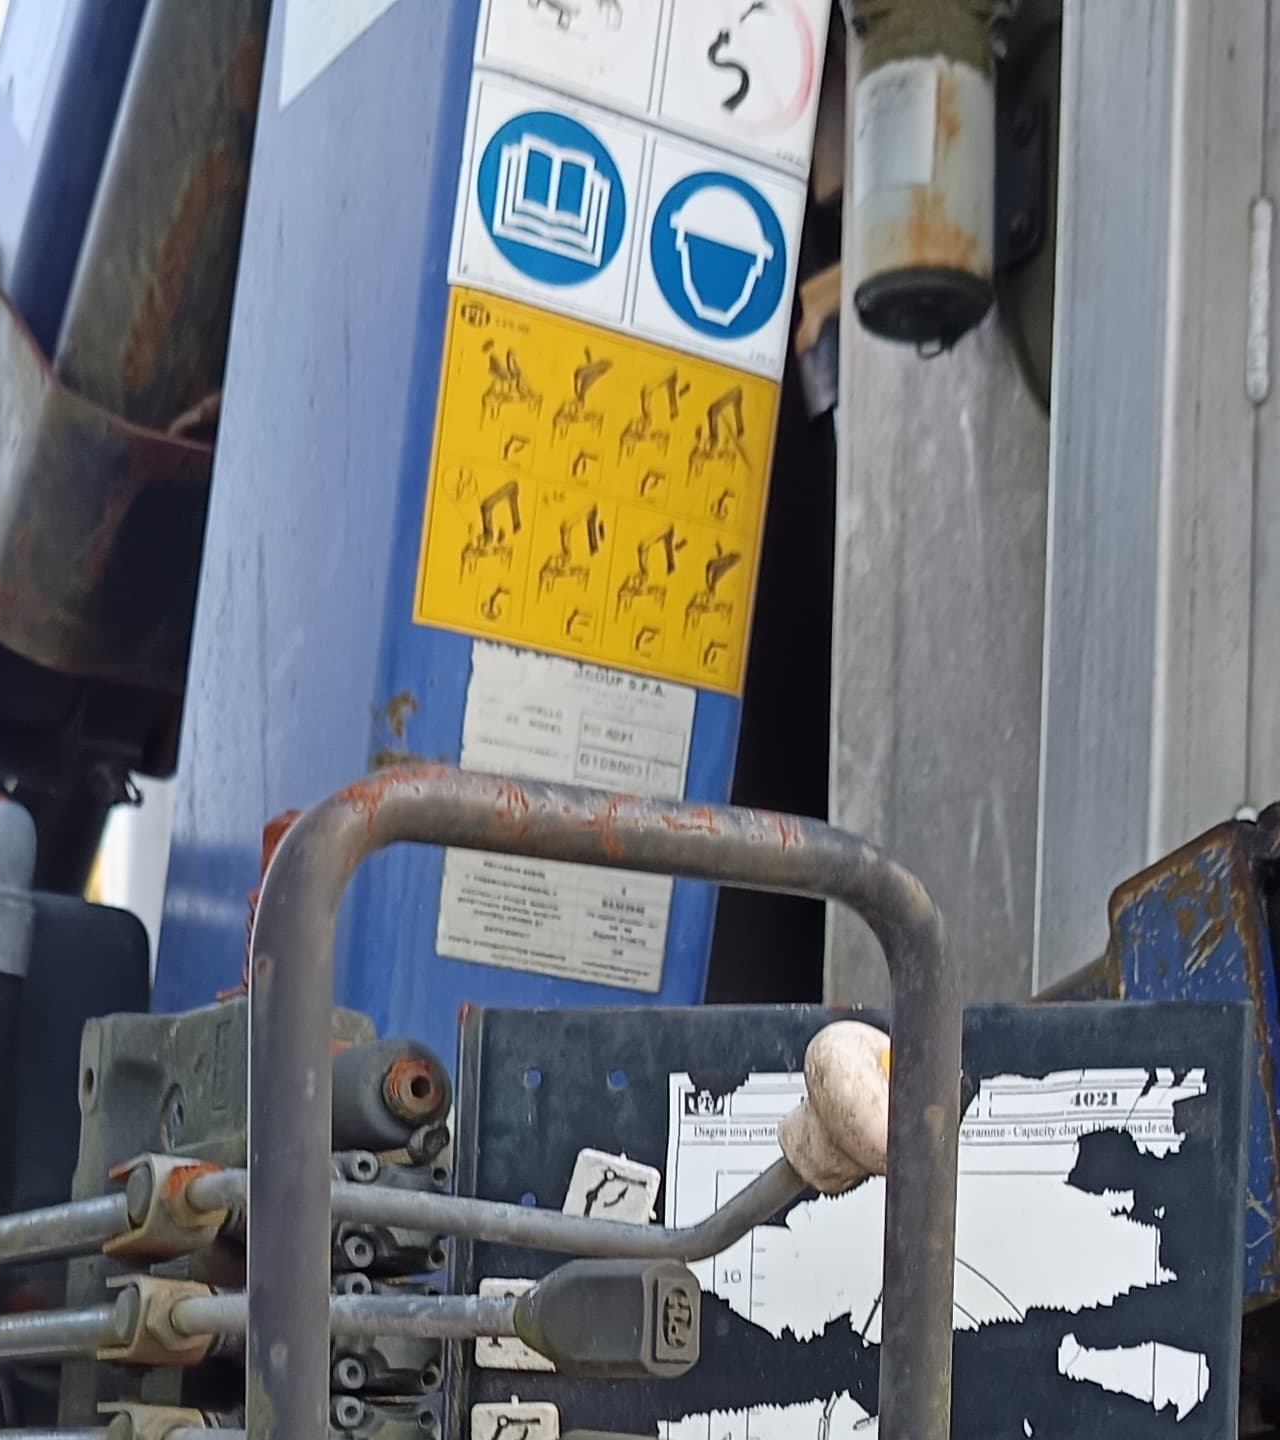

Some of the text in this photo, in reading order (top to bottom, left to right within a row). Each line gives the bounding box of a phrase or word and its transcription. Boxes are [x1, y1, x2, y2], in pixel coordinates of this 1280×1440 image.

[1071, 1091, 1119, 1107] 4021
[1012, 1124, 1057, 1140] Capacity
[1144, 1121, 1158, 1134] de
[721, 1268, 742, 1284] 10
